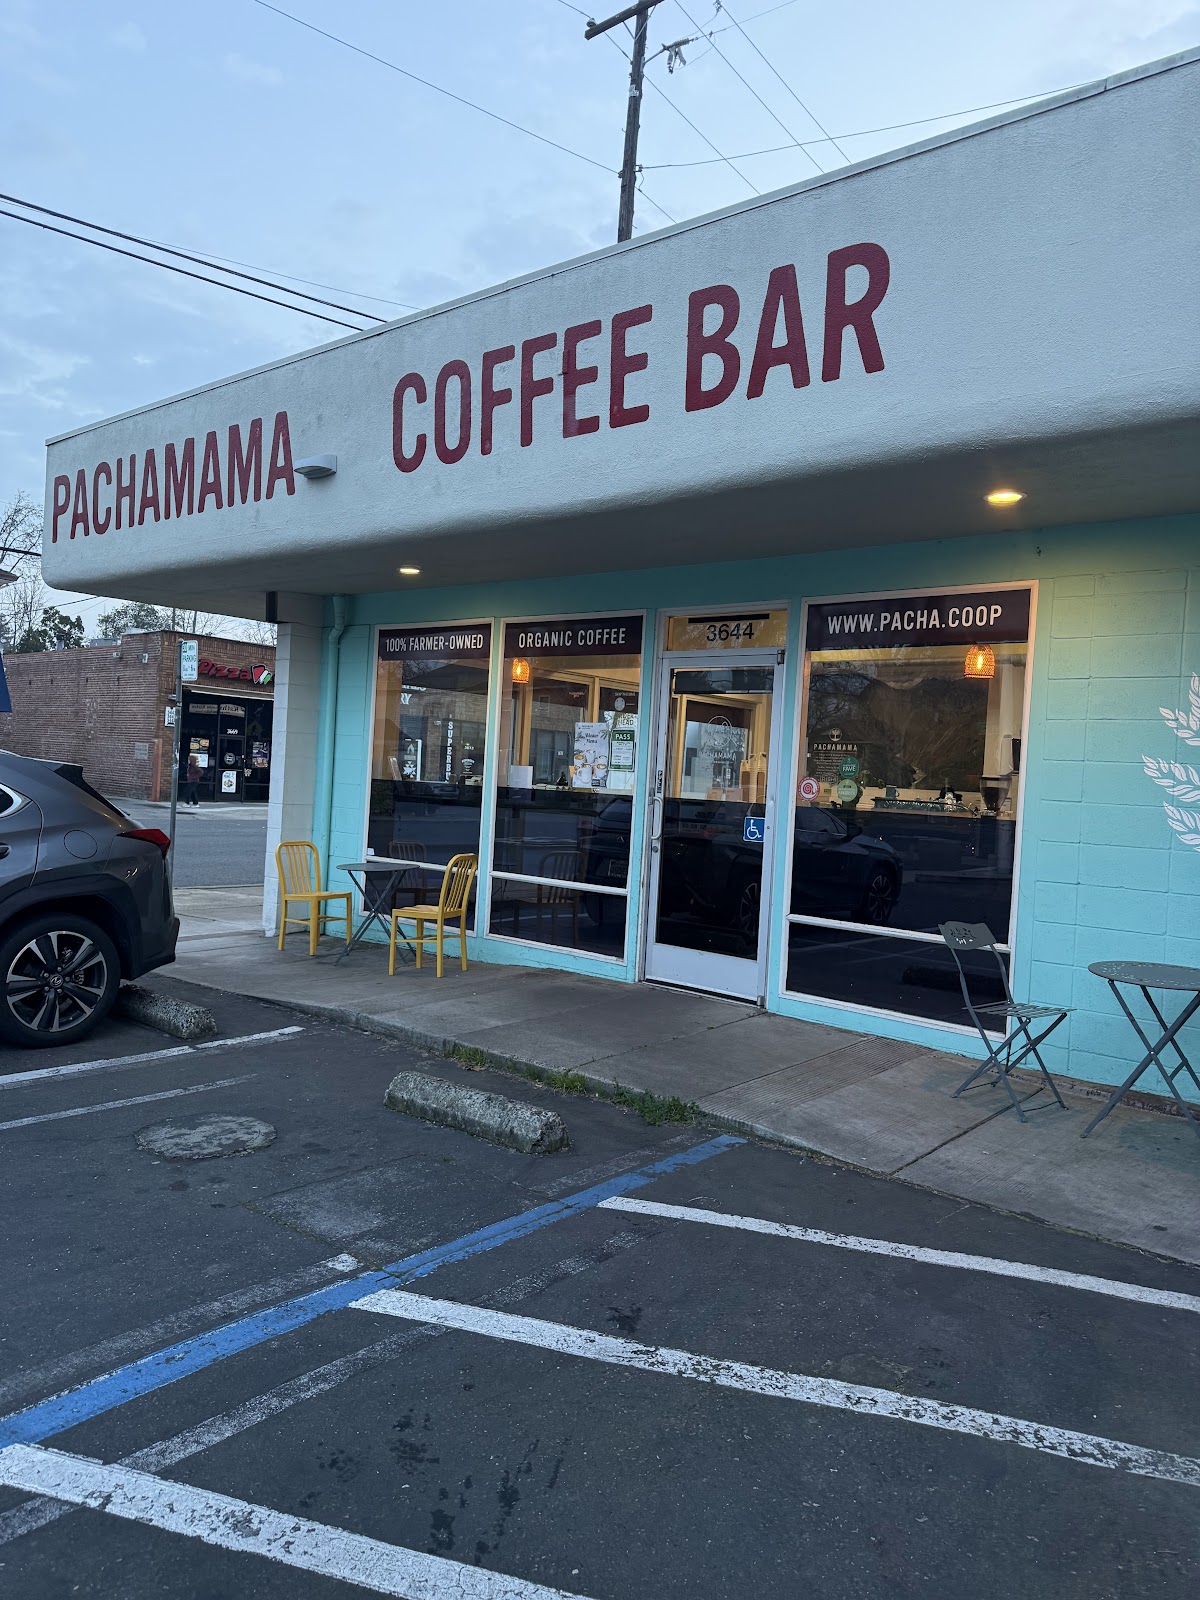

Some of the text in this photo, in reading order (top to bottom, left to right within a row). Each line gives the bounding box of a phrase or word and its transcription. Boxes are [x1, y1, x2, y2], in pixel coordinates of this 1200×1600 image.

[52, 242, 890, 543] PACHAMAMA COFFEE BAR
[827, 605, 1003, 635] WWW.PACHA.COOP
[518, 627, 626, 649] ORGANIC COFFEE
[706, 622, 755, 642] 3644
[385, 634, 484, 652] 100% FARMER-OWNED
[198, 659, 250, 680] Pizza
